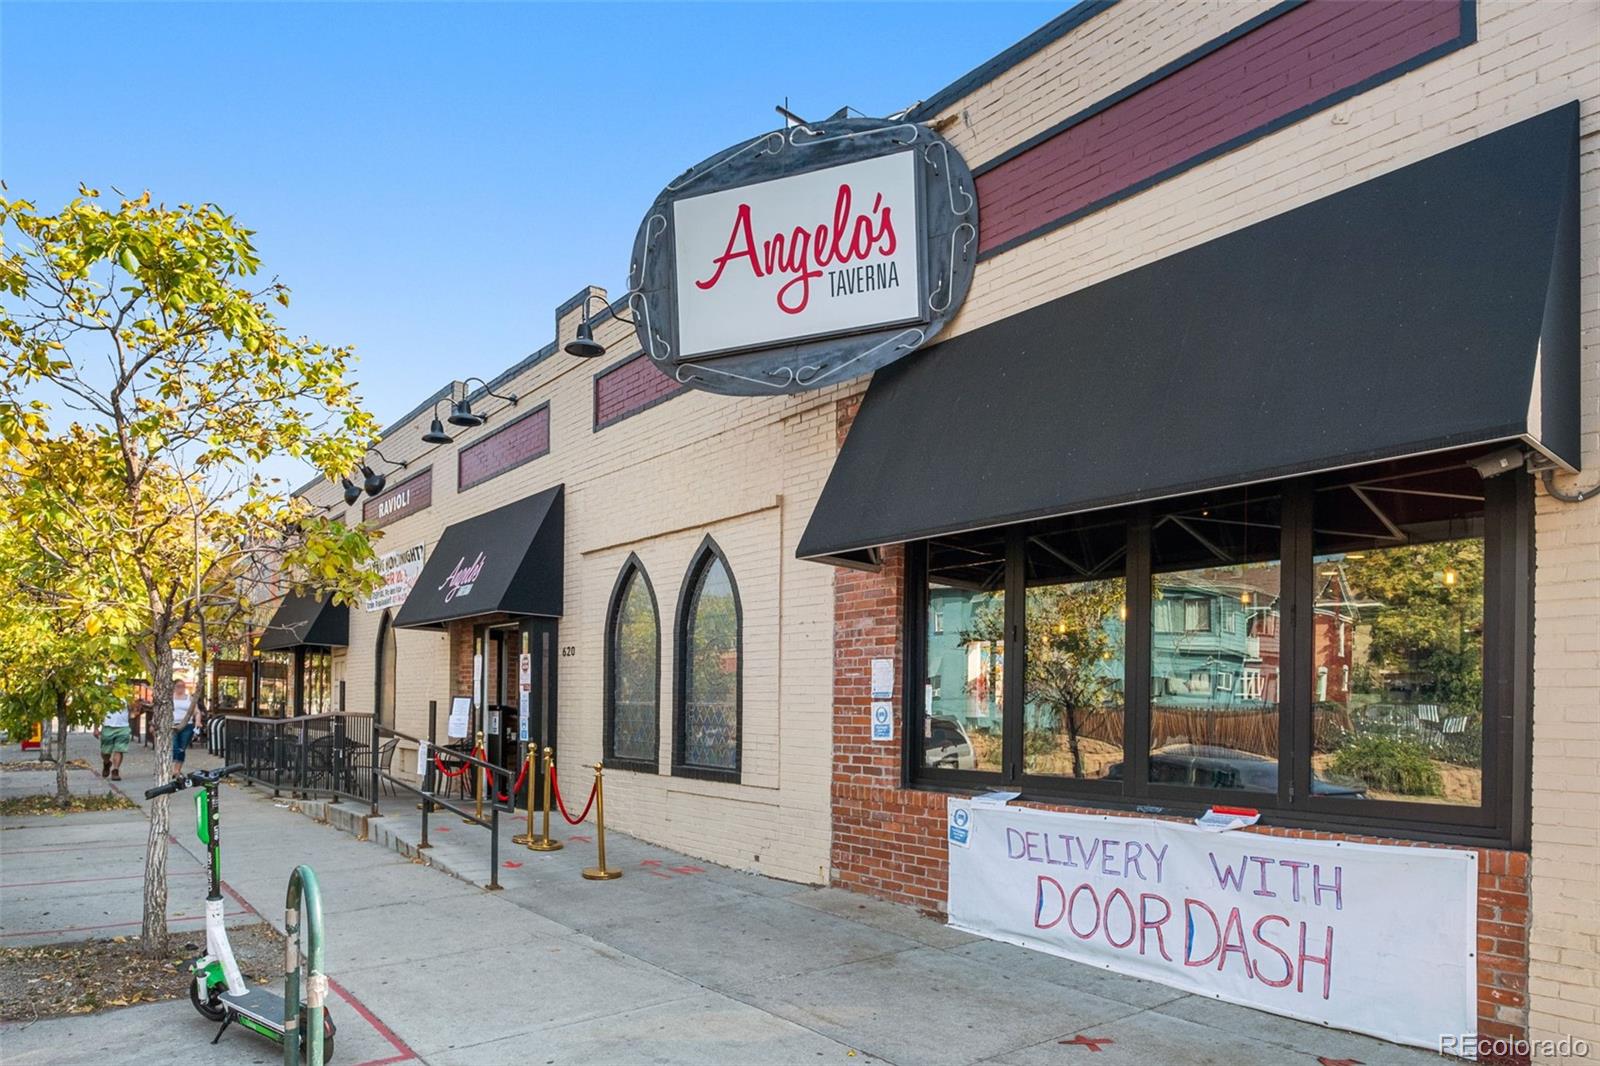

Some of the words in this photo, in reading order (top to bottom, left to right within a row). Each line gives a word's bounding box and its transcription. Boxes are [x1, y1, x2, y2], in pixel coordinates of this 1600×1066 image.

[696, 184, 897, 314] Angelo's
[828, 261, 899, 298] TAVERNA
[378, 489, 410, 518] RAVIOLI
[562, 646, 576, 657] 620
[1005, 826, 1169, 883] DELIVERY
[1209, 852, 1343, 910] WITH
